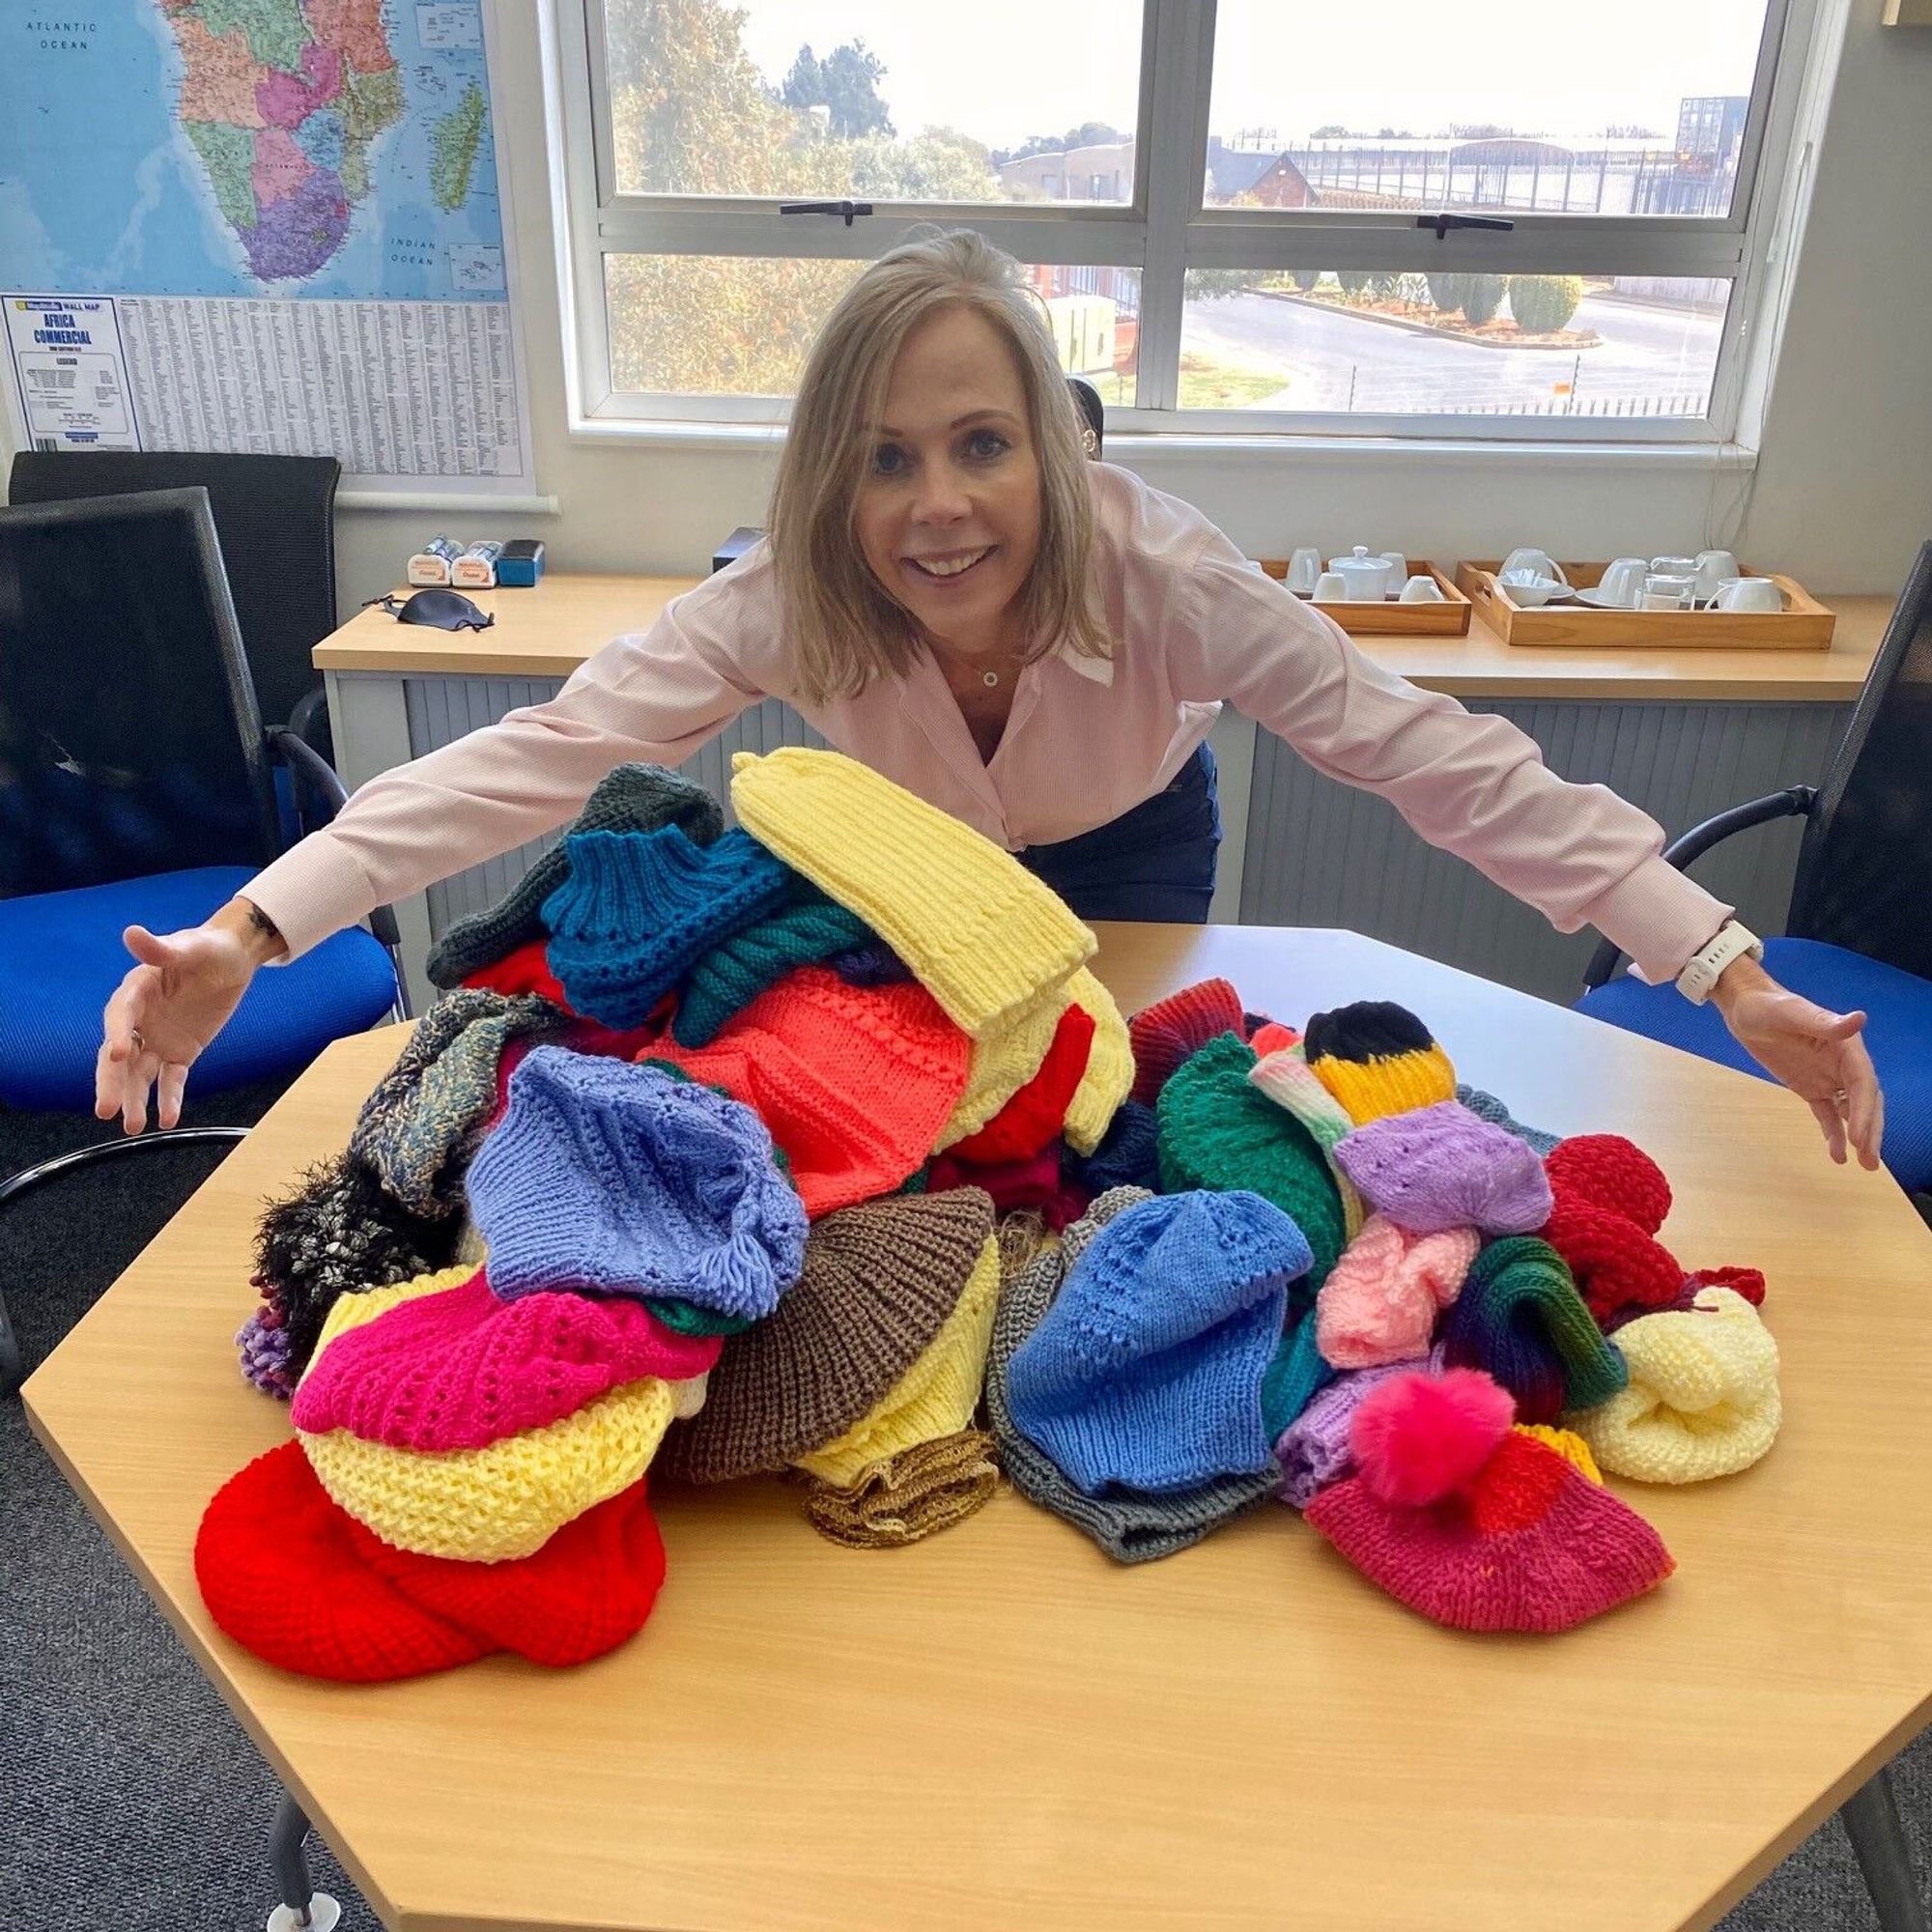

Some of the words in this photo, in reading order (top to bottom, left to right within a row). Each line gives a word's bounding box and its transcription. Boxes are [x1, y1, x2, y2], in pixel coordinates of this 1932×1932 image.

[26, 22, 97, 32] ATLANTIC
[41, 41, 88, 49] OCEAN
[391, 239, 436, 249] INDIAN
[391, 255, 433, 265] OCEAN
[44, 314, 75, 327] AFRICA
[34, 330, 92, 344] COMMERCIAL
